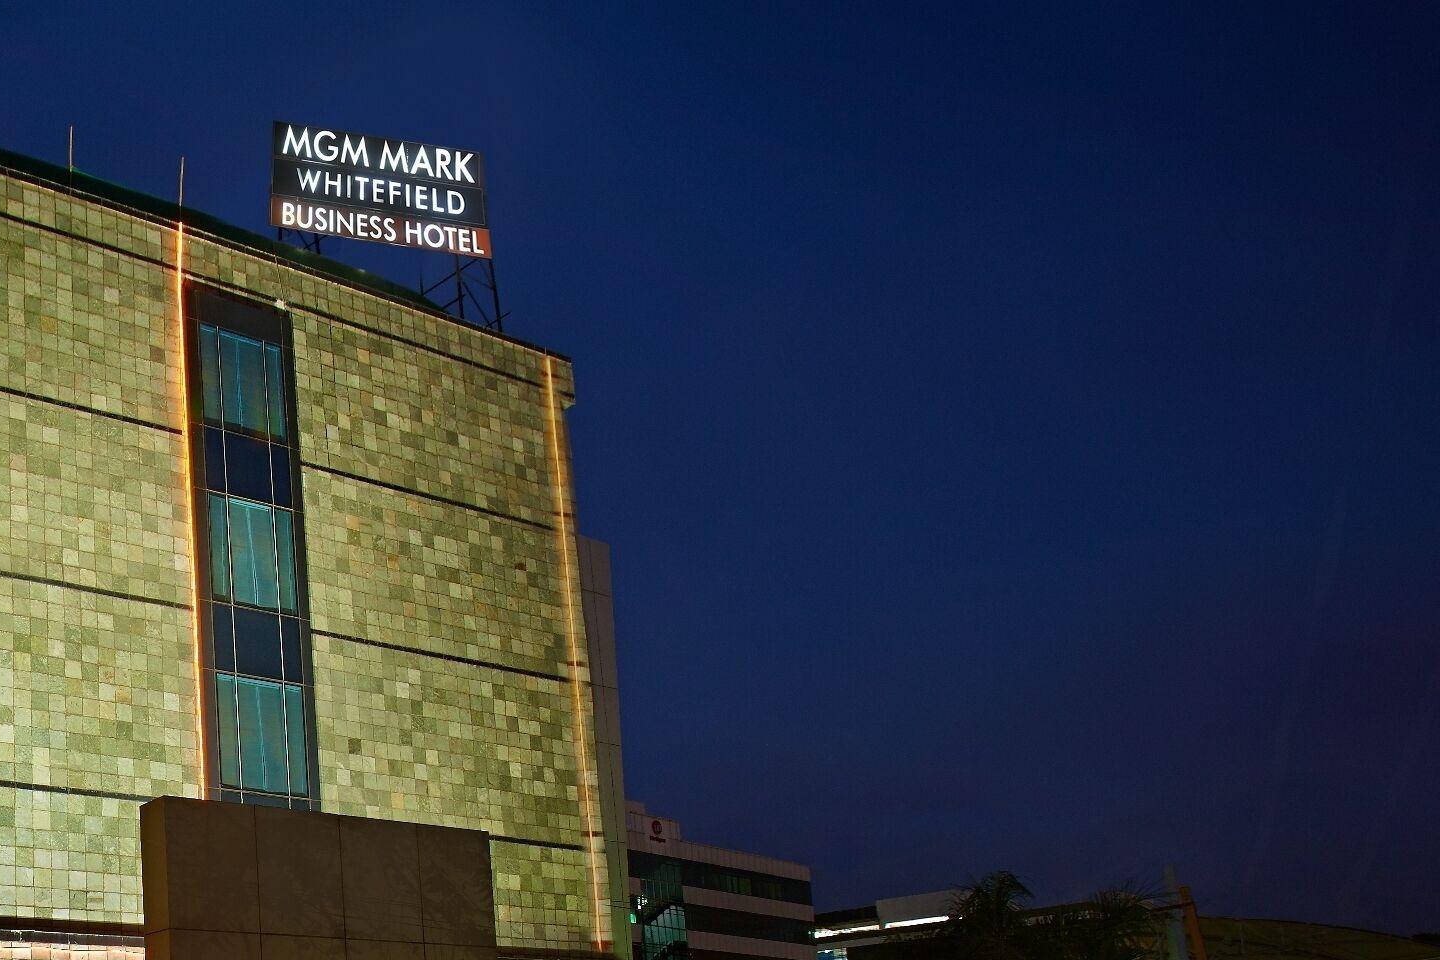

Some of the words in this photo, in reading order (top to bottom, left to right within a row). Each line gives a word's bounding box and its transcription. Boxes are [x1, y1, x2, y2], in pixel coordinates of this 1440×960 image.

[282, 124, 370, 168] MGM
[379, 140, 477, 184] MARK
[296, 167, 466, 215] WHITEFIELD
[281, 202, 397, 242] BUSINESS
[405, 220, 485, 255] HOTEL
